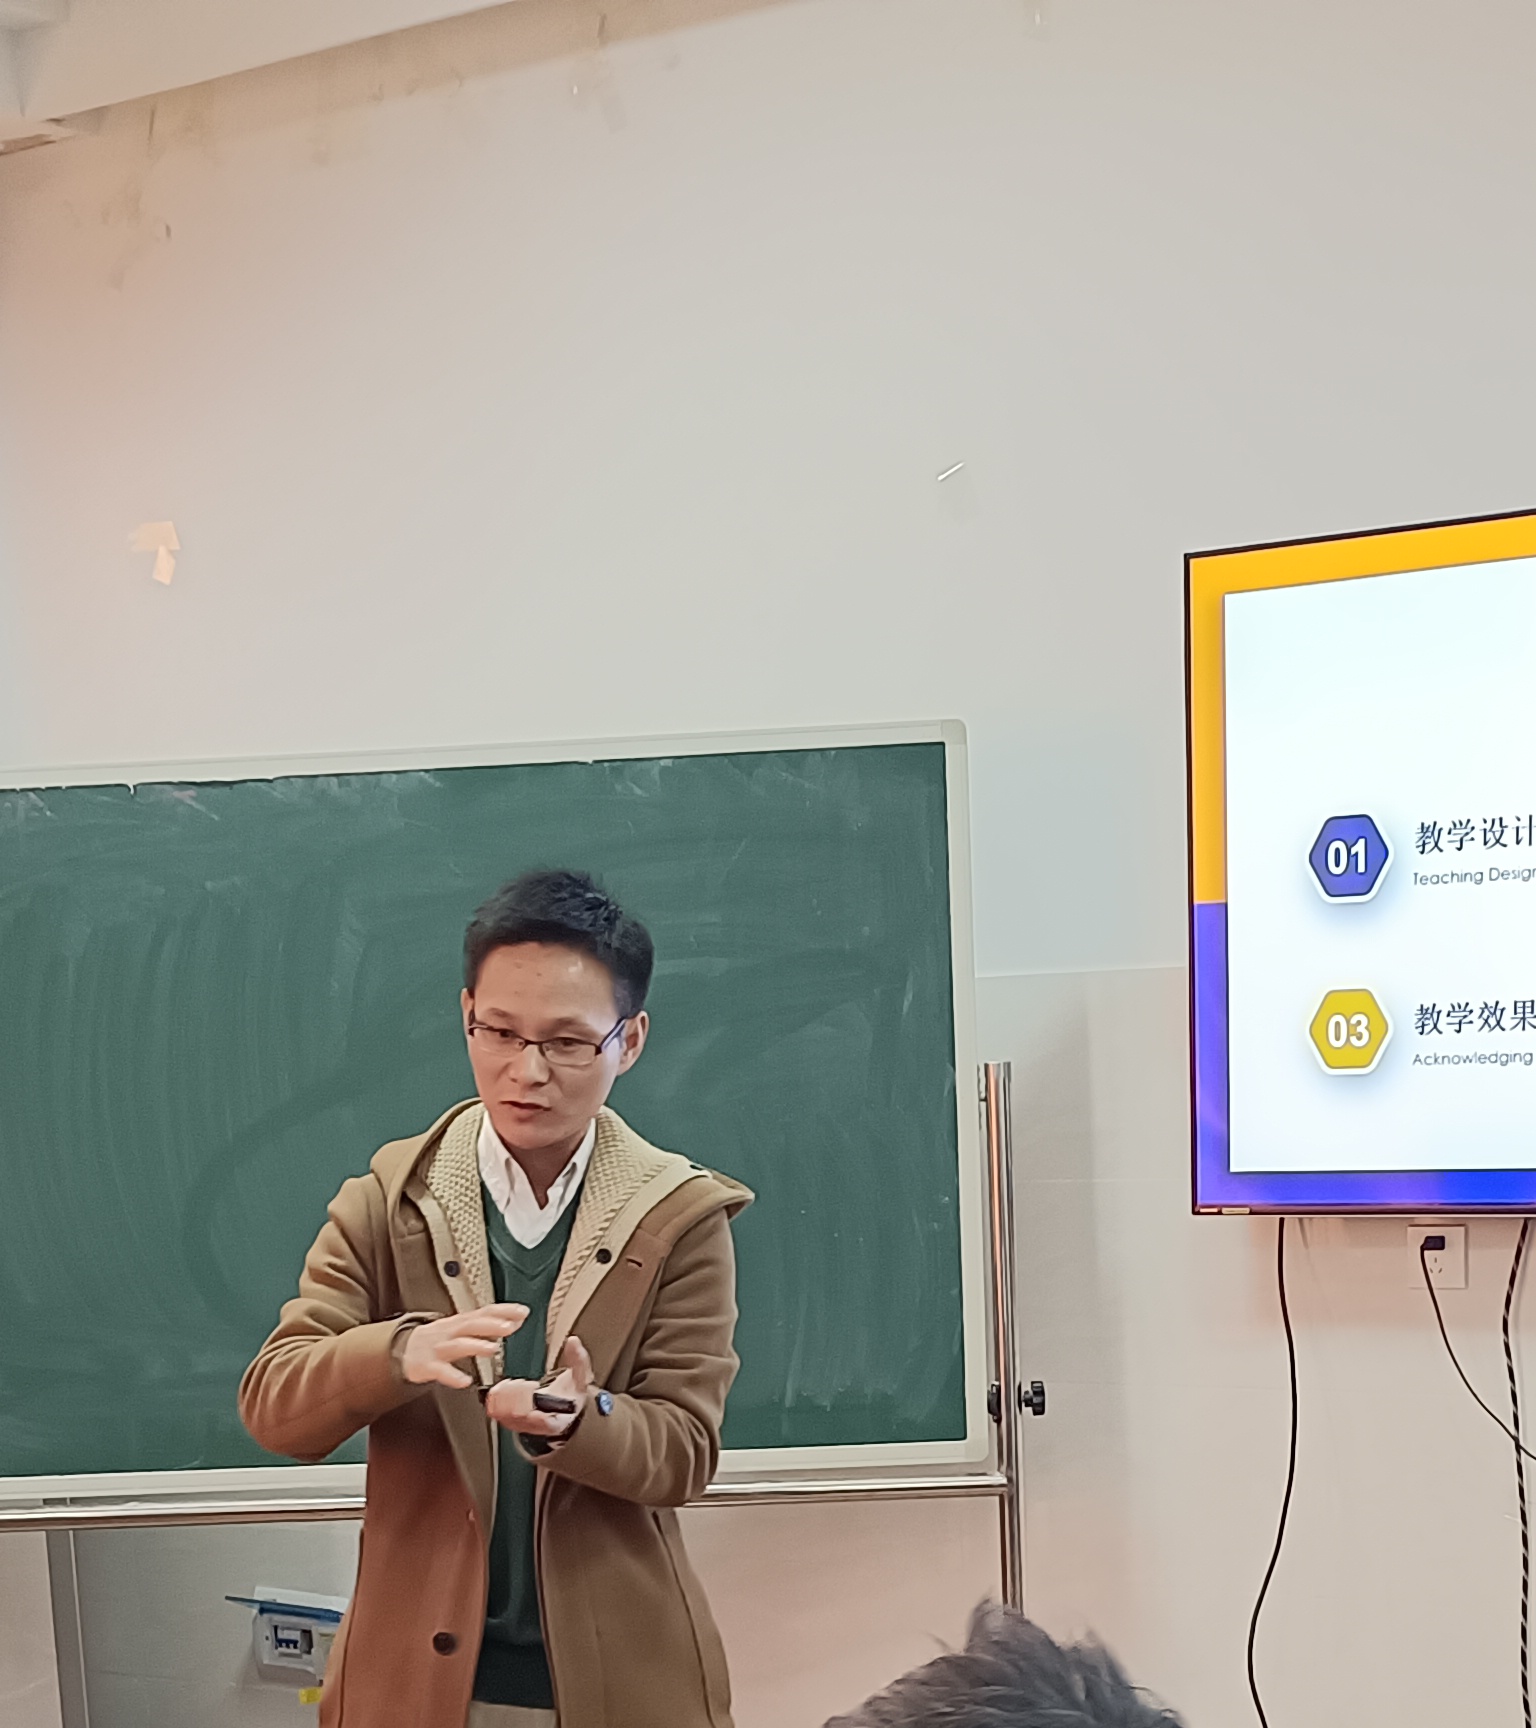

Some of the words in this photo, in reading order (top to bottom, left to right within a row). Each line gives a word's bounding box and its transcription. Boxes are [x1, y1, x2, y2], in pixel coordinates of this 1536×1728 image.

[1325, 837, 1368, 876] 01
[1413, 868, 1484, 886] Teaching
[1327, 1013, 1371, 1049] 03
[1412, 1049, 1534, 1067] Acknowledging
